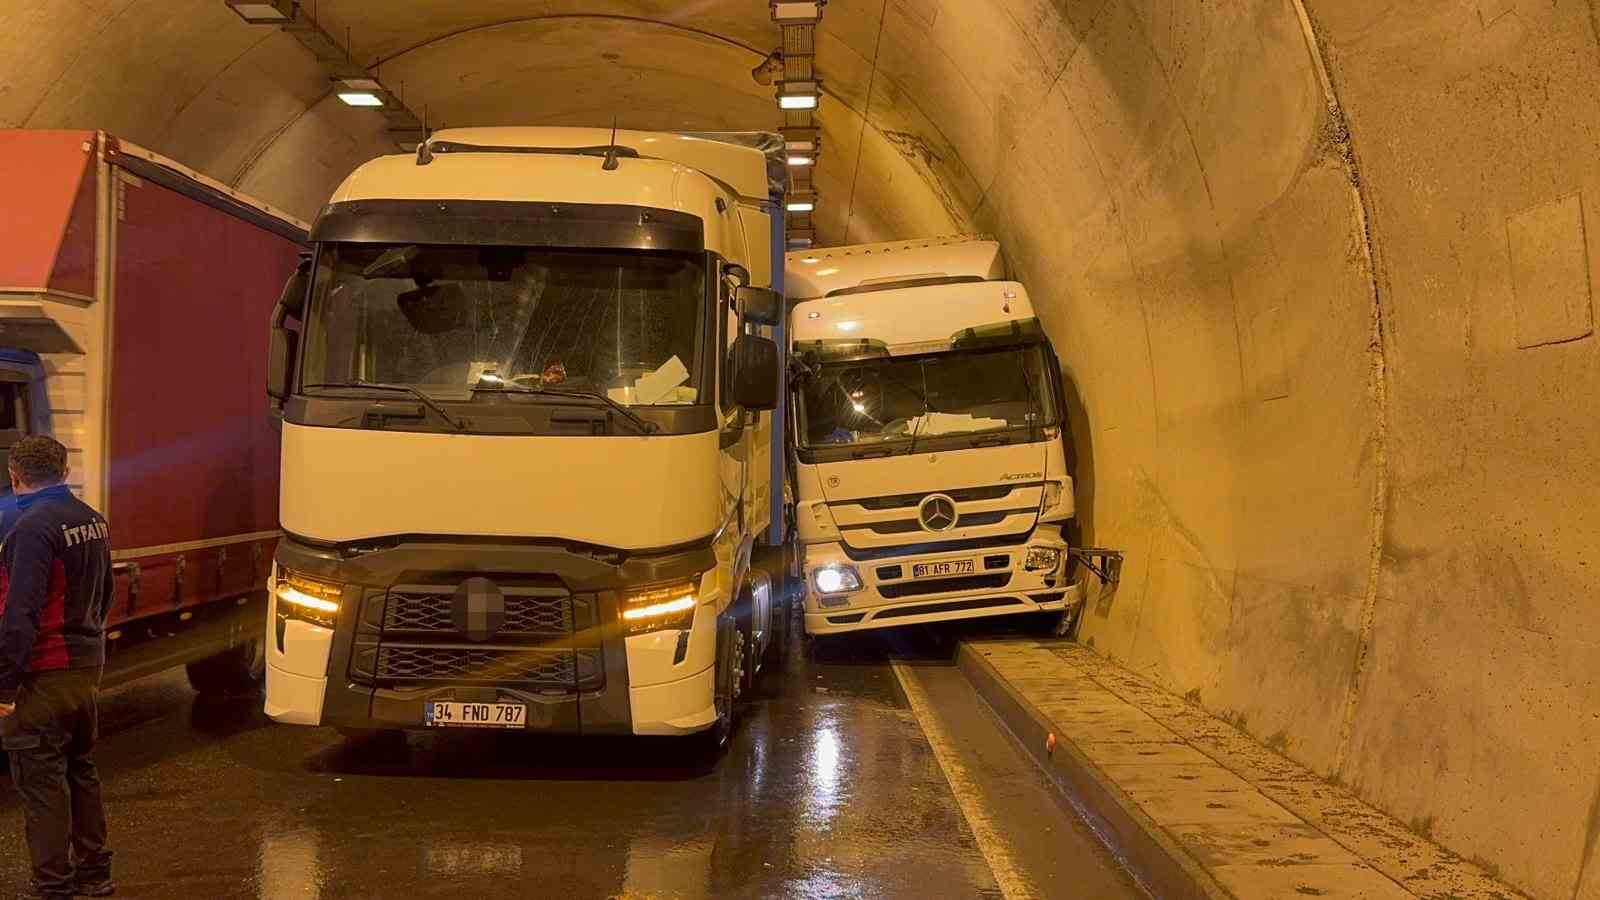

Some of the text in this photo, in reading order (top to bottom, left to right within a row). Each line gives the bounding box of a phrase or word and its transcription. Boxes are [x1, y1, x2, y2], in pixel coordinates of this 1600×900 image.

[933, 563, 950, 574] AFR
[955, 561, 972, 573] 772
[435, 704, 522, 722] 34 FND 787
